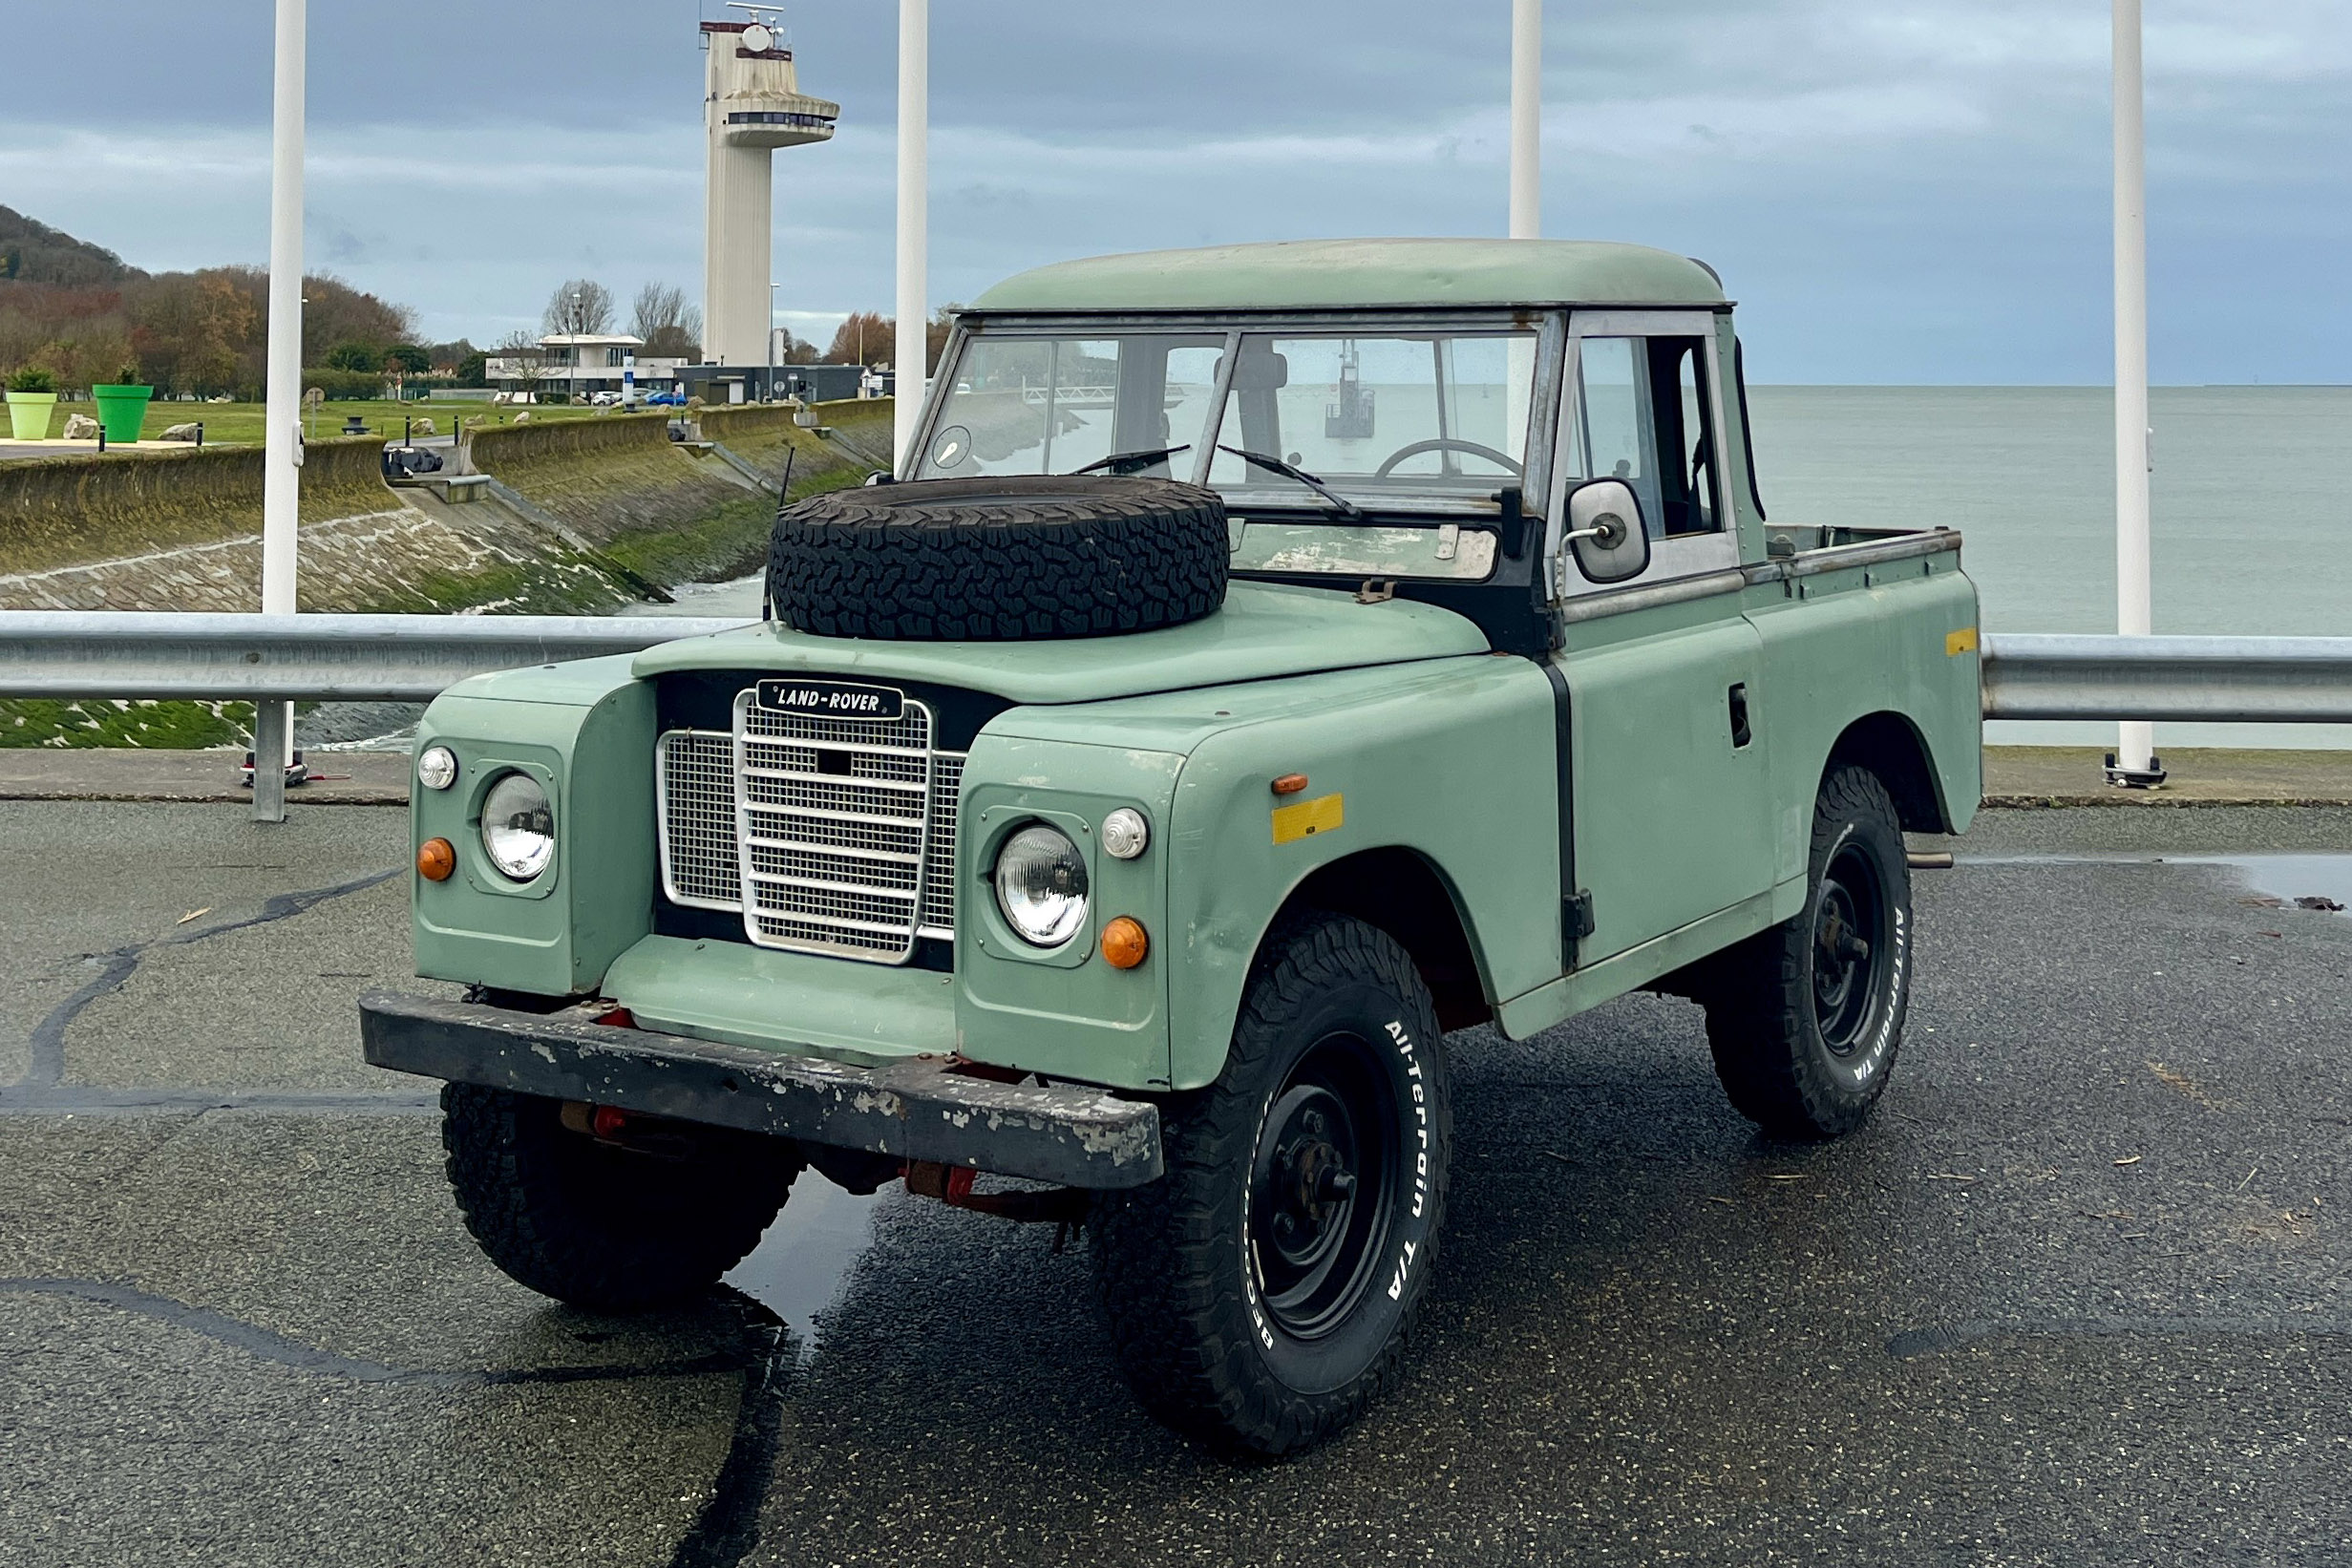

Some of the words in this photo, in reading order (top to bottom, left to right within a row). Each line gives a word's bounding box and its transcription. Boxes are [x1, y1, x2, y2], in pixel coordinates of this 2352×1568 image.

[777, 689, 879, 711] LAND-ROVER
[1874, 906, 1904, 1057] All-Terrain
[1854, 1059, 1875, 1081] T/A
[1385, 1021, 1429, 1218] All-Terrain
[1388, 1240, 1416, 1301] T/A
